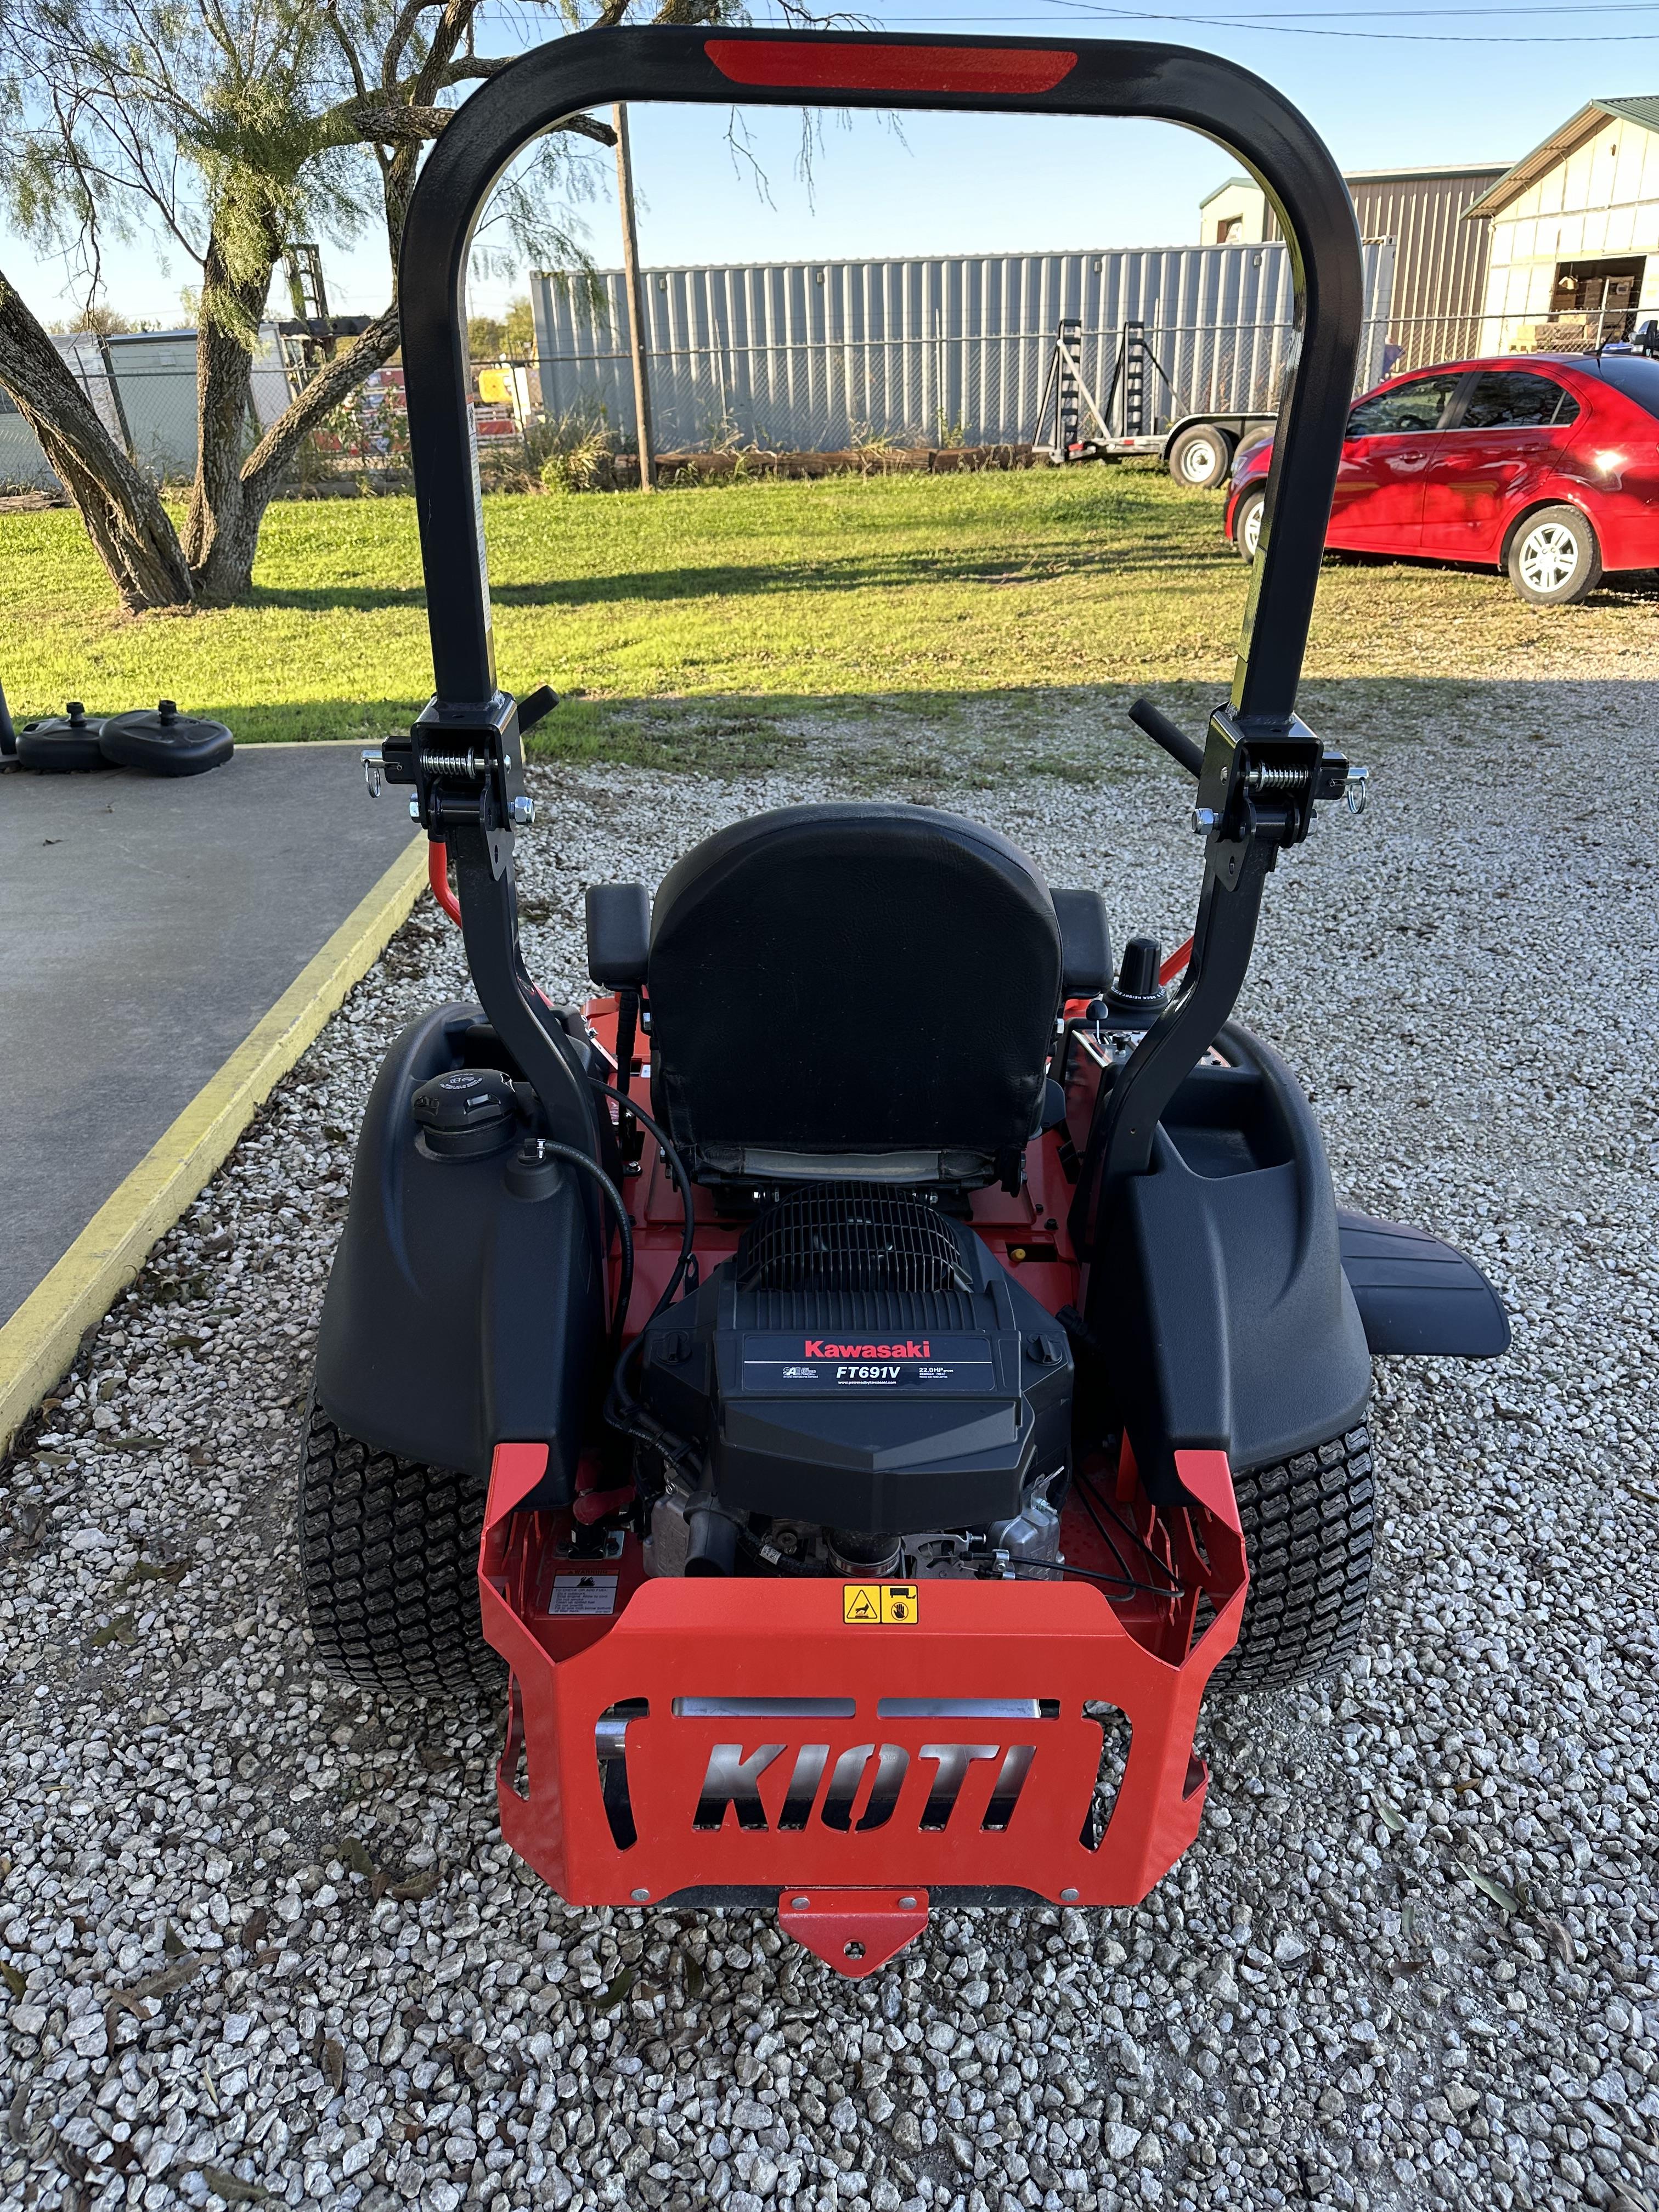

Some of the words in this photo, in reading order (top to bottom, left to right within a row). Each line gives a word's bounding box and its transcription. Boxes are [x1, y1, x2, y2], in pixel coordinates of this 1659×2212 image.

[805, 1340, 930, 1358] Kawasaki
[836, 1366, 901, 1379] FT691V
[692, 1743, 1037, 1833] KIOTI
